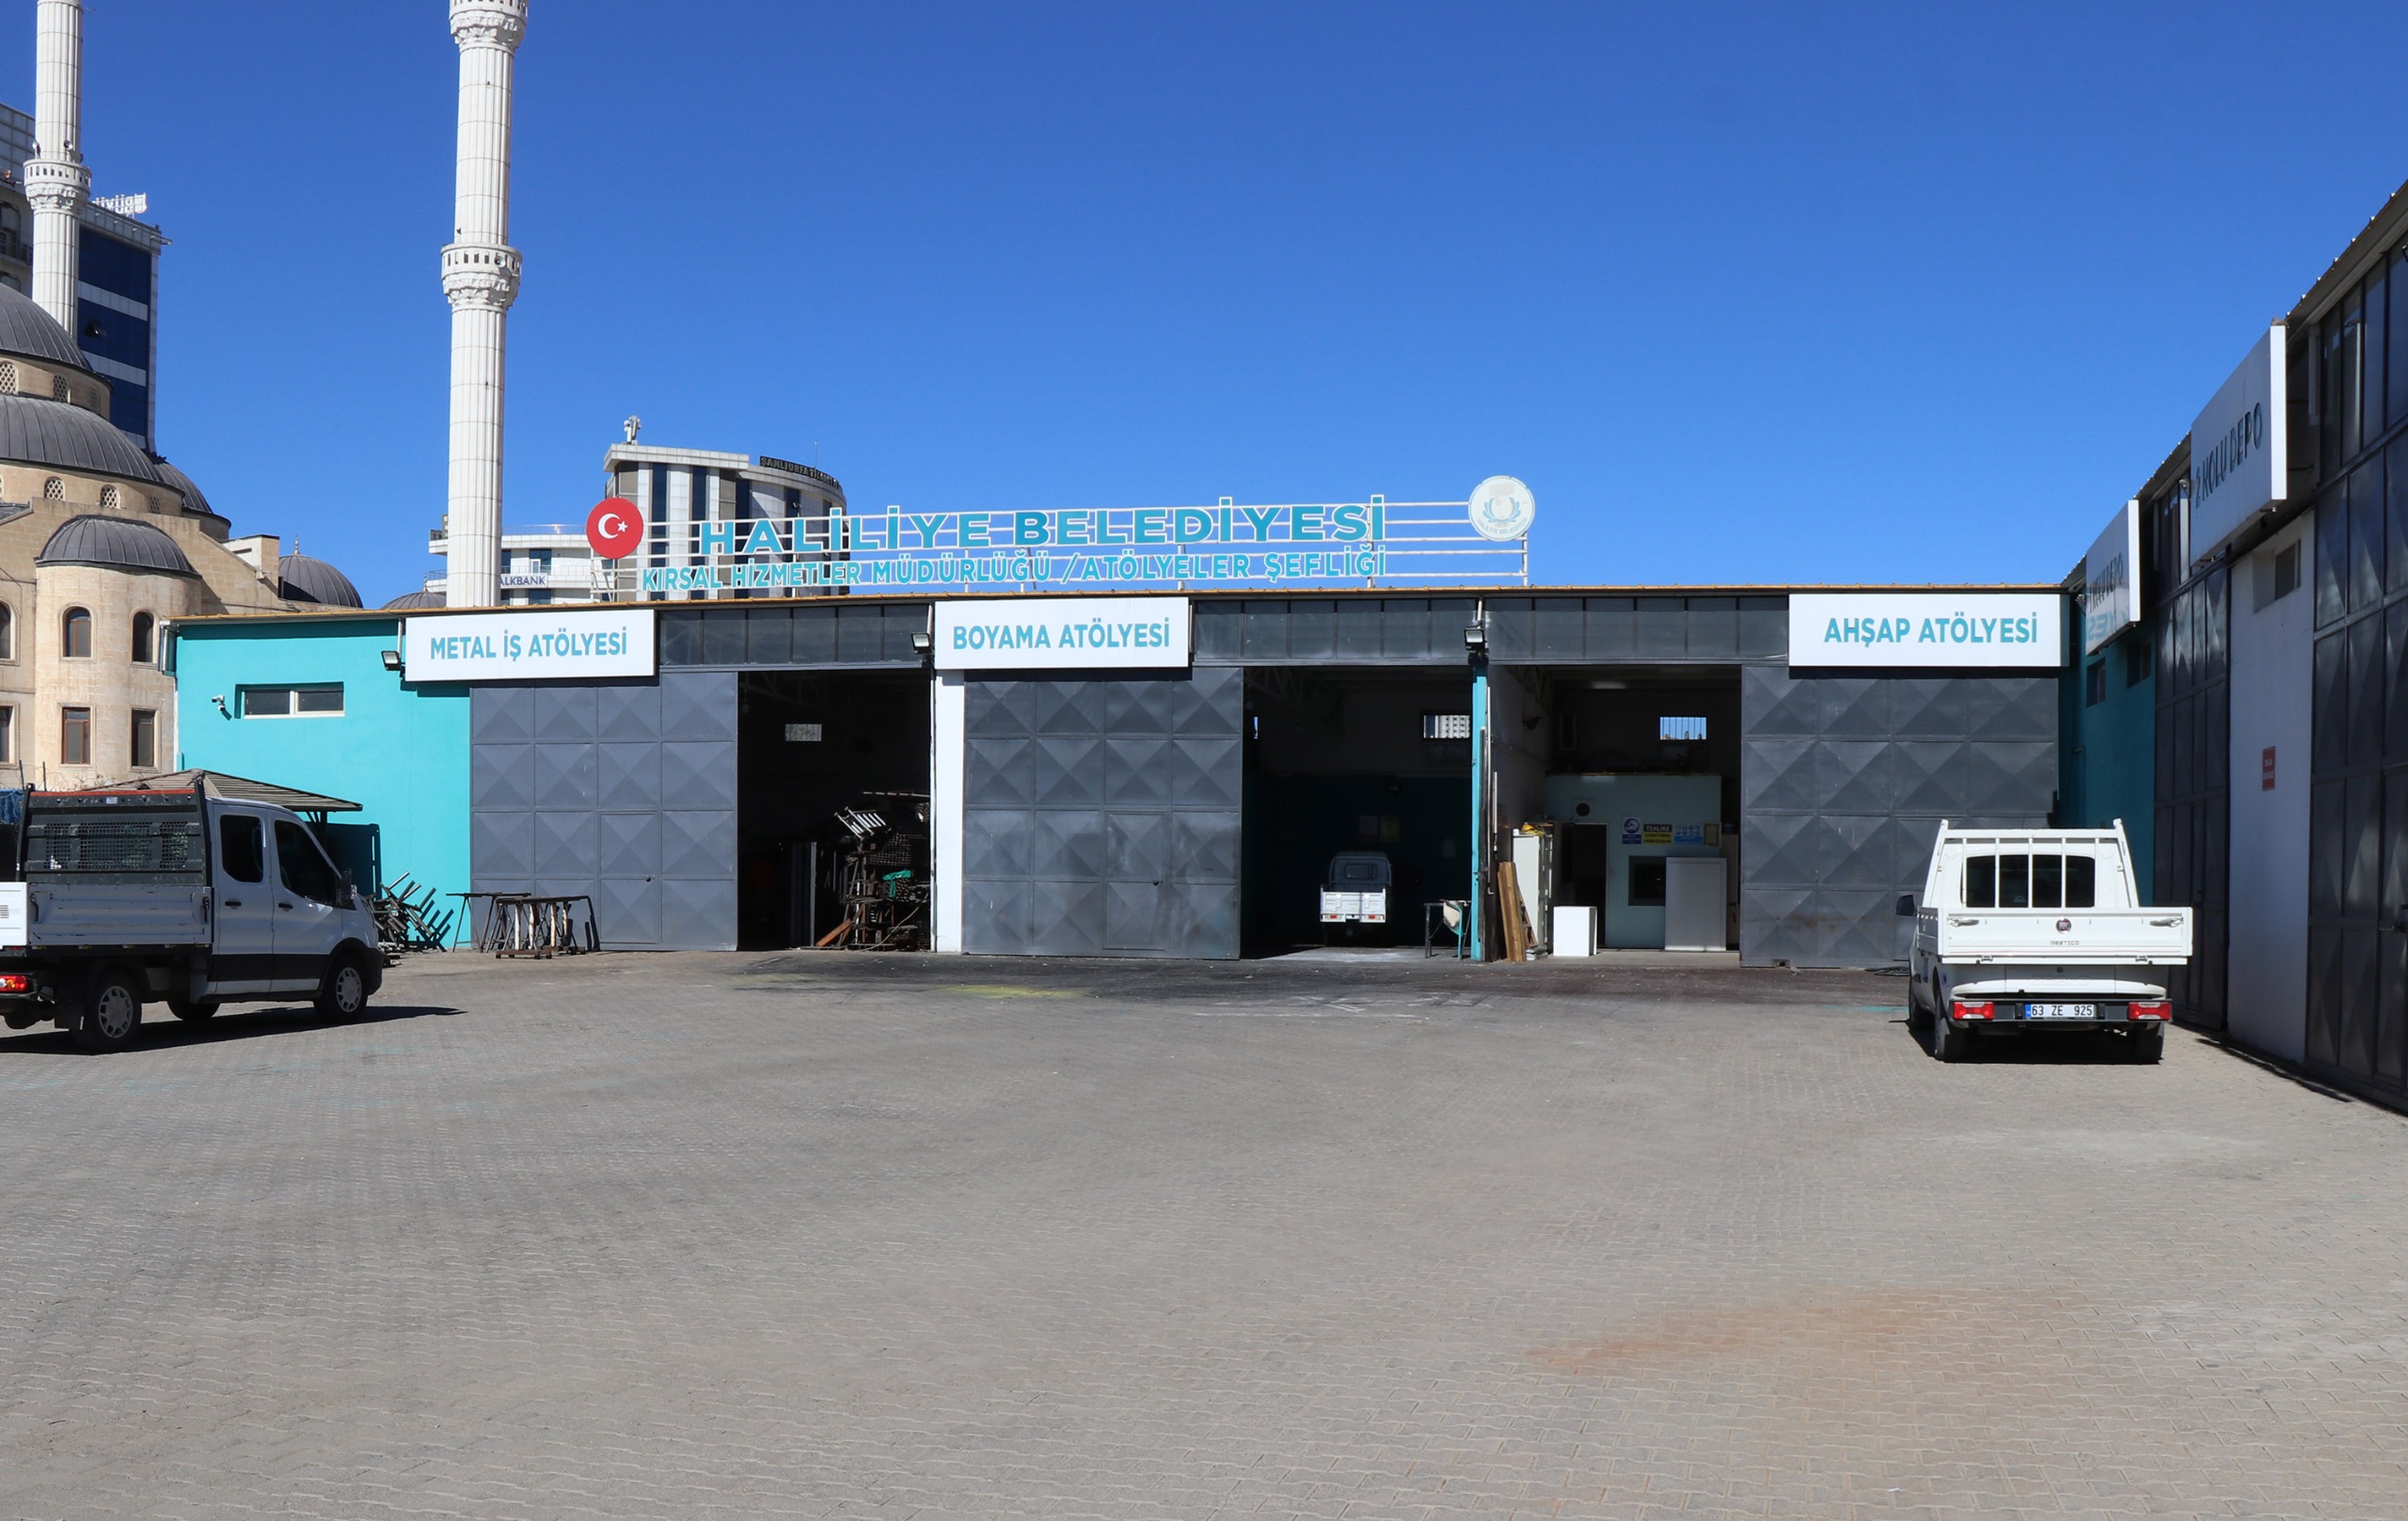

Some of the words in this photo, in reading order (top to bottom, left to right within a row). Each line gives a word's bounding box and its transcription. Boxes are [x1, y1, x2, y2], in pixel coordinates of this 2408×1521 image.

[2195, 467, 2201, 509] 2
[2202, 436, 2227, 501] NOLU
[2229, 403, 2262, 473] DEPO
[699, 505, 991, 556] HALİLİYE
[1013, 495, 1385, 547] BELEDİYESİ
[642, 564, 722, 592] KIRSAL
[730, 558, 862, 590] HİZMETLER
[872, 549, 1052, 585] MÜDÜRLÜĞÜ
[1264, 545, 1386, 584] ŞEFLİĞİ
[431, 636, 497, 659] METAL
[503, 629, 522, 662] İŞ
[528, 626, 626, 657] ATÖLYESİ
[953, 625, 1052, 650] BOYAMA
[1058, 617, 1170, 649] ATÖLYESİ
[1823, 617, 1911, 649] AHŞAP
[1917, 611, 2037, 643] ATÖLYESİ
[2032, 1006, 2044, 1016] 63
[2052, 1006, 2064, 1016] ZE
[2074, 1006, 2093, 1016] 925
